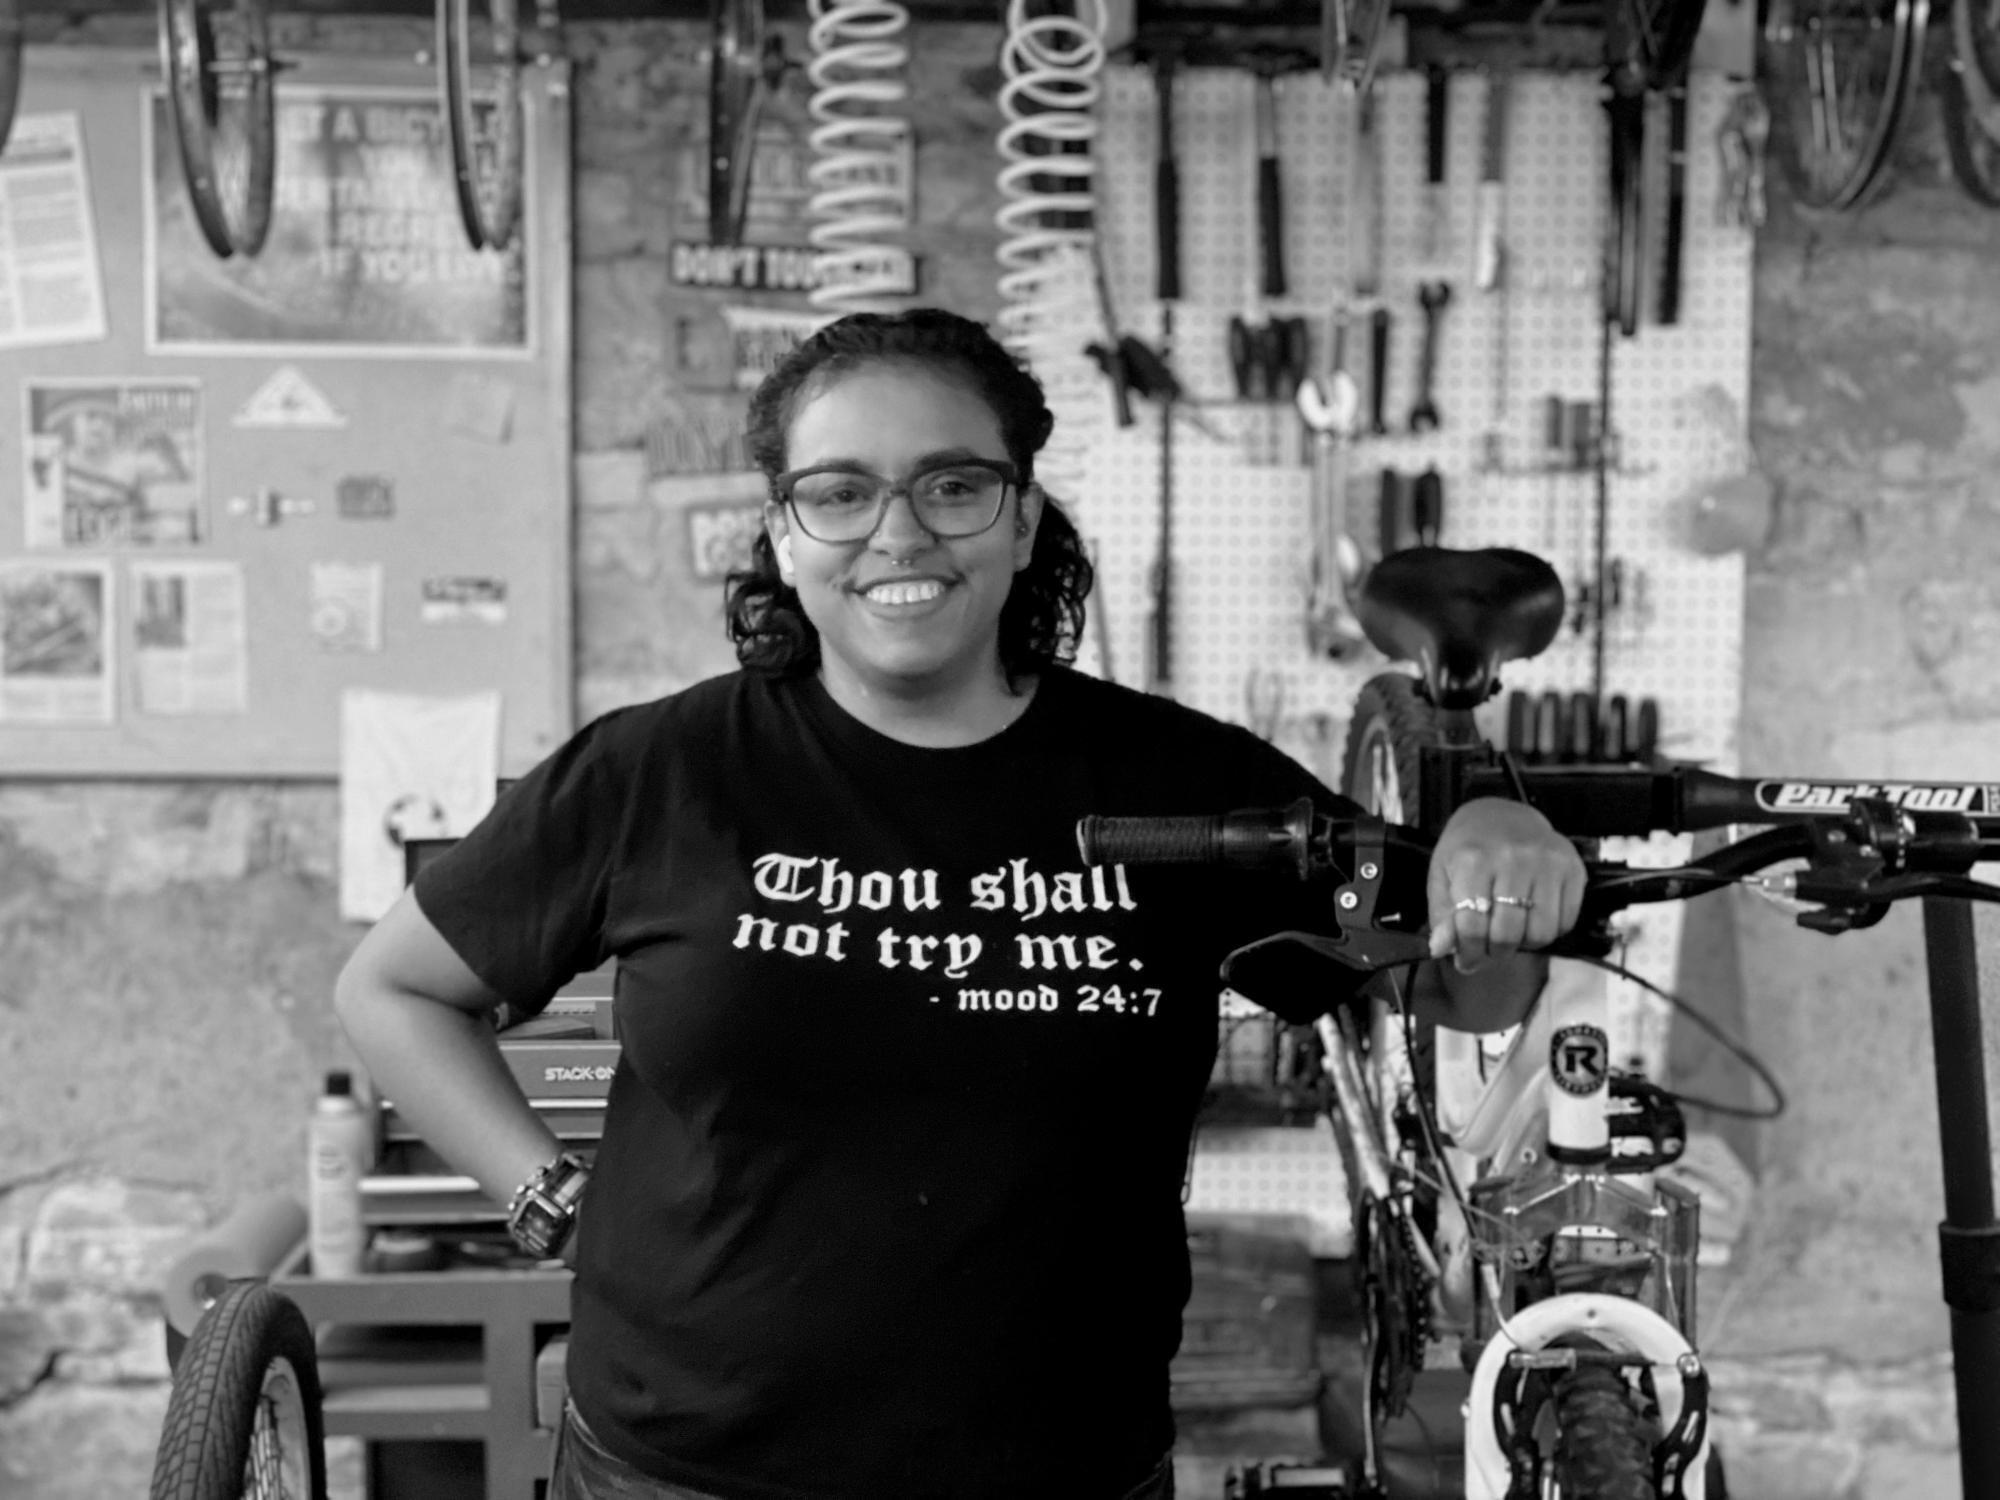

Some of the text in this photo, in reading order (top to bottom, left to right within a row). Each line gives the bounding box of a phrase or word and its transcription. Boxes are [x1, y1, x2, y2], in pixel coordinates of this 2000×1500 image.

[752, 853, 1138, 921] Thou shall
[733, 914, 1144, 979] not try me.
[957, 984, 1060, 1012] mood
[1076, 984, 1163, 1017] 24:7
